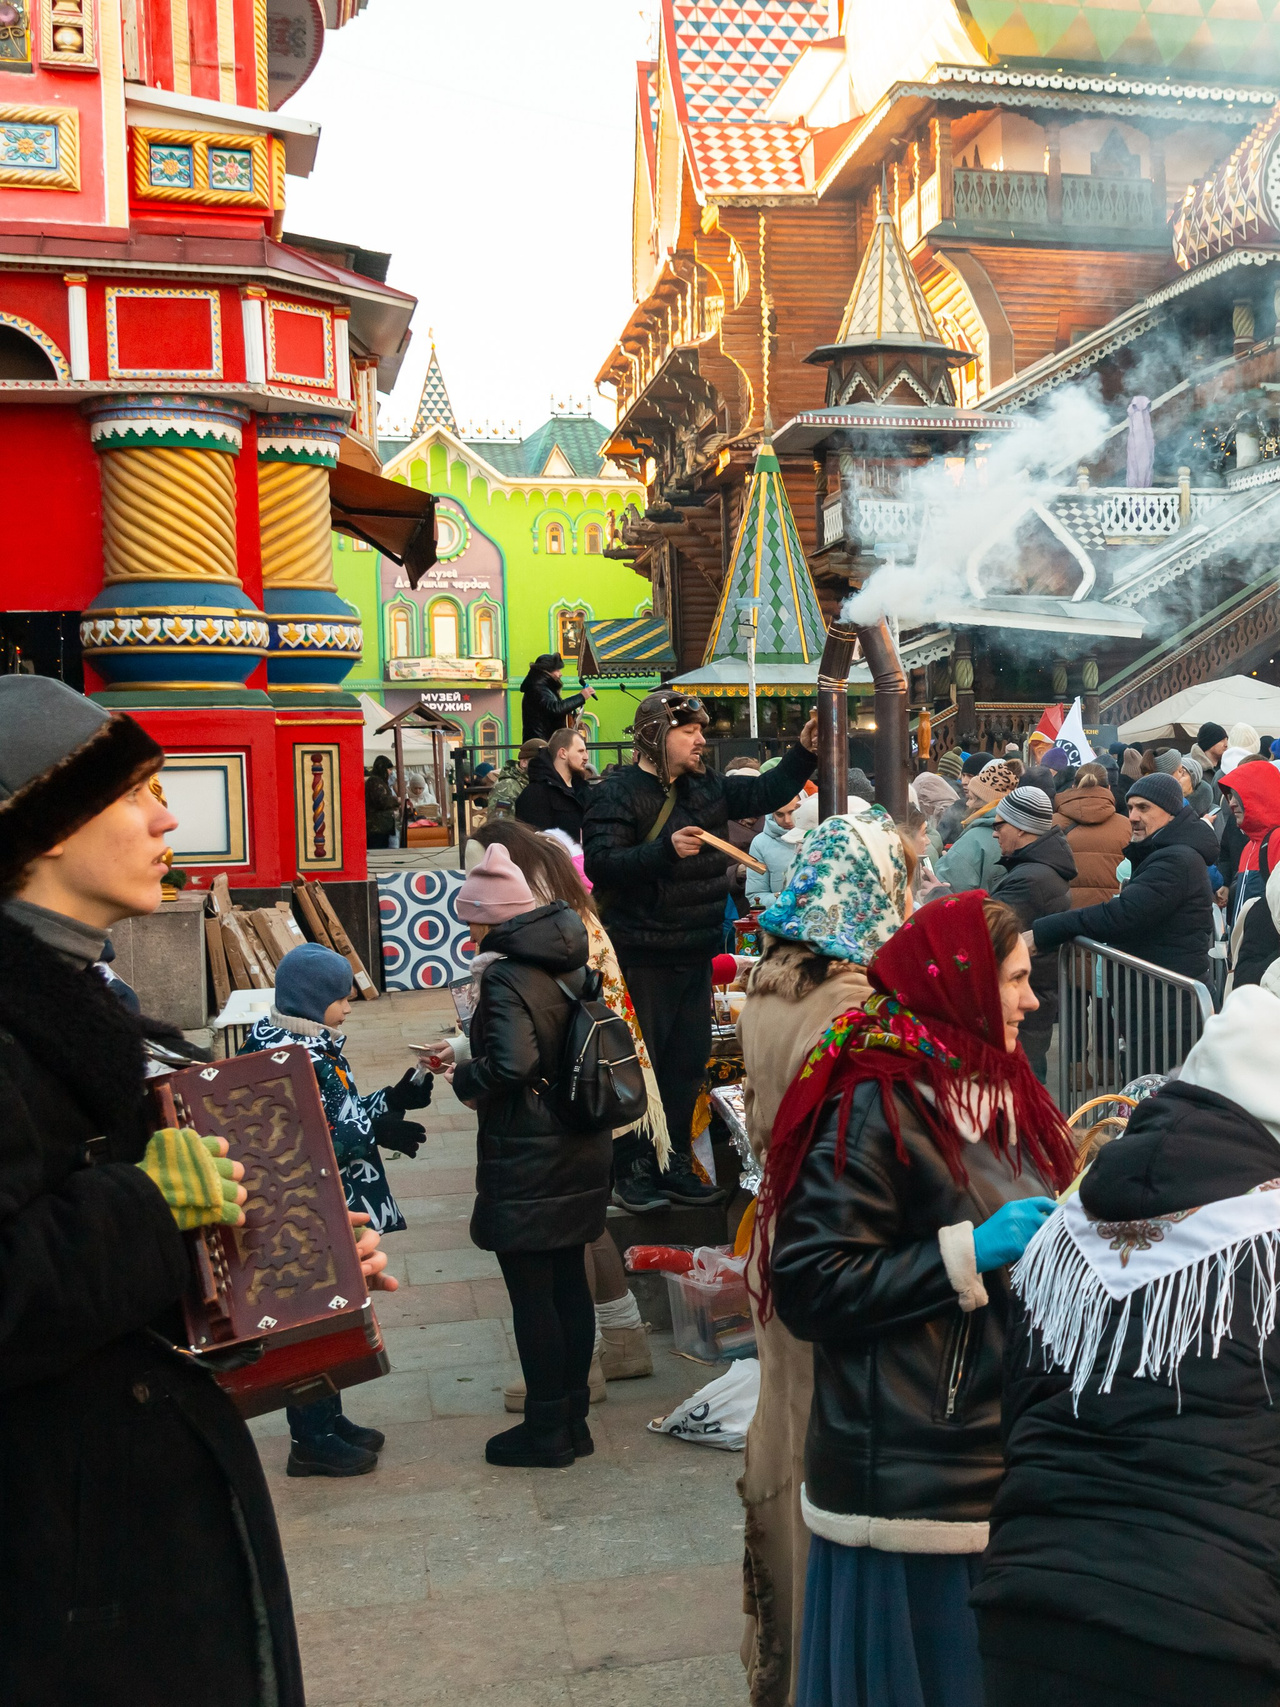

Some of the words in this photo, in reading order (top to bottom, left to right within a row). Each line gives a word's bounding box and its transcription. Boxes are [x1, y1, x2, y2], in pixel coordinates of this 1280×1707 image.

[428, 569, 458, 580] музей
[394, 576, 449, 591] Деушкин
[451, 577, 491, 592] чердак
[421, 691, 461, 702] МУЗЕЙ
